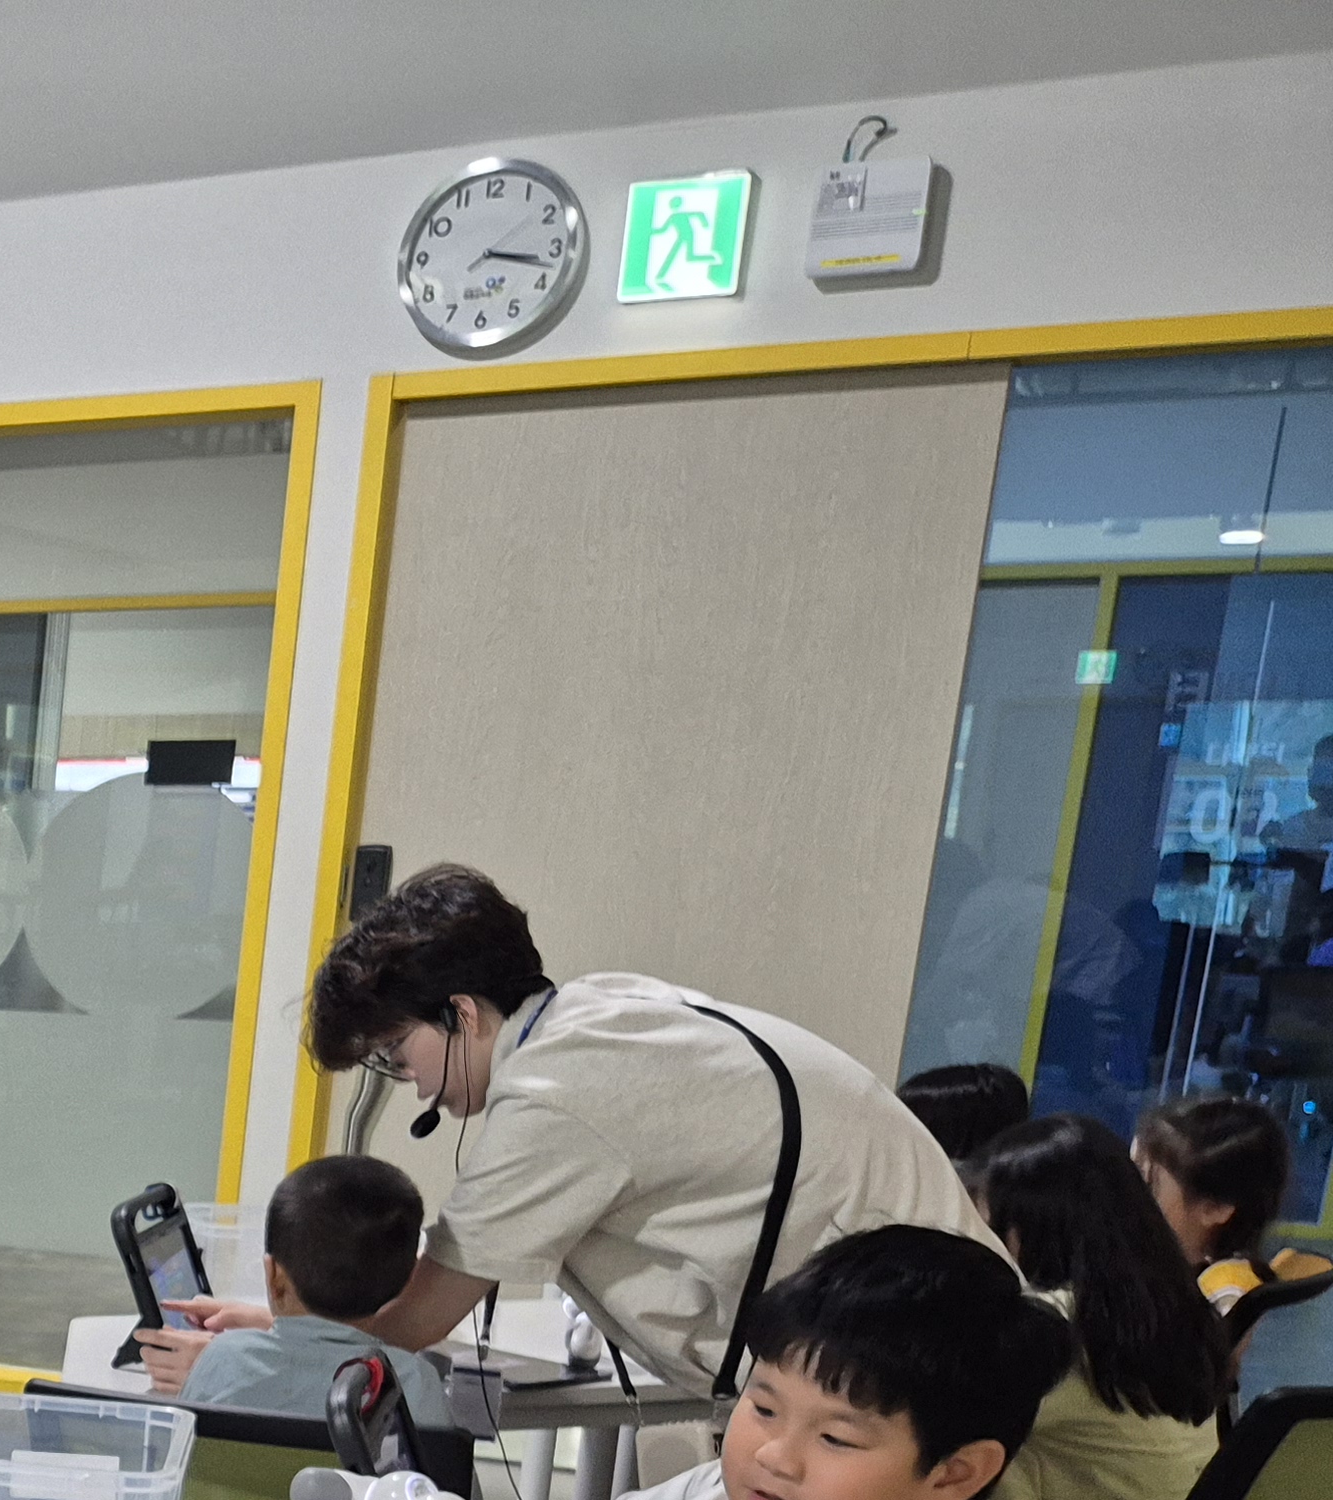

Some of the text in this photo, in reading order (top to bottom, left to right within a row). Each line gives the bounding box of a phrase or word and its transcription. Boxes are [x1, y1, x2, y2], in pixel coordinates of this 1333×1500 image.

[455, 187, 471, 210] 11
[486, 178, 506, 200] 12
[525, 180, 533, 203] 1
[541, 203, 558, 226] 2
[428, 215, 453, 239] 10
[548, 236, 563, 259] 3
[416, 250, 430, 270] 9
[534, 271, 548, 292] 4
[422, 283, 435, 304] 8
[445, 303, 459, 324] 7
[507, 298, 521, 319] 5
[474, 309, 488, 330] 6
